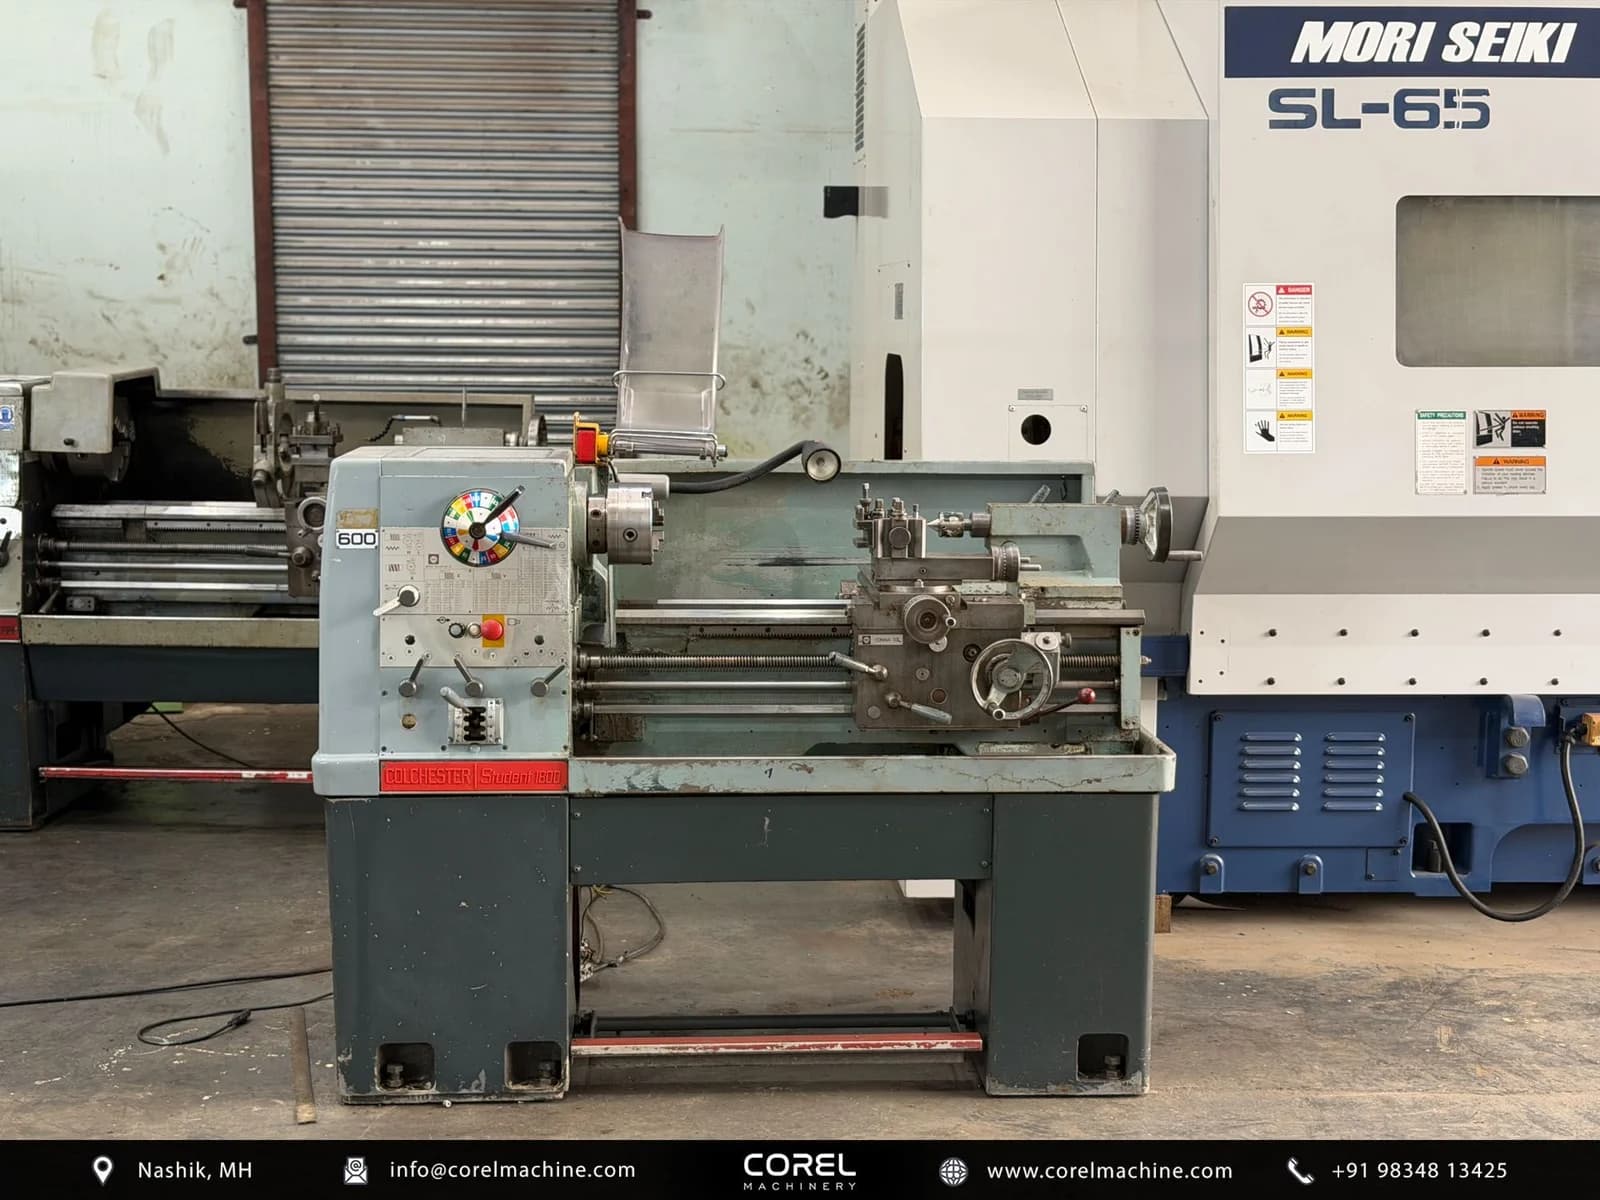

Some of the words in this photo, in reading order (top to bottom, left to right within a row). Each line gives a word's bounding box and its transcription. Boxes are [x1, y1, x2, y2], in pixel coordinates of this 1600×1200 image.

[1290, 21, 1437, 63] MORI
[1441, 22, 1578, 63] SEIKI
[1268, 88, 1491, 129] SL-65
[338, 533, 376, 545] 600
[385, 767, 471, 785] COLCHESTER
[480, 767, 534, 785] Student
[535, 769, 561, 785] 1800
